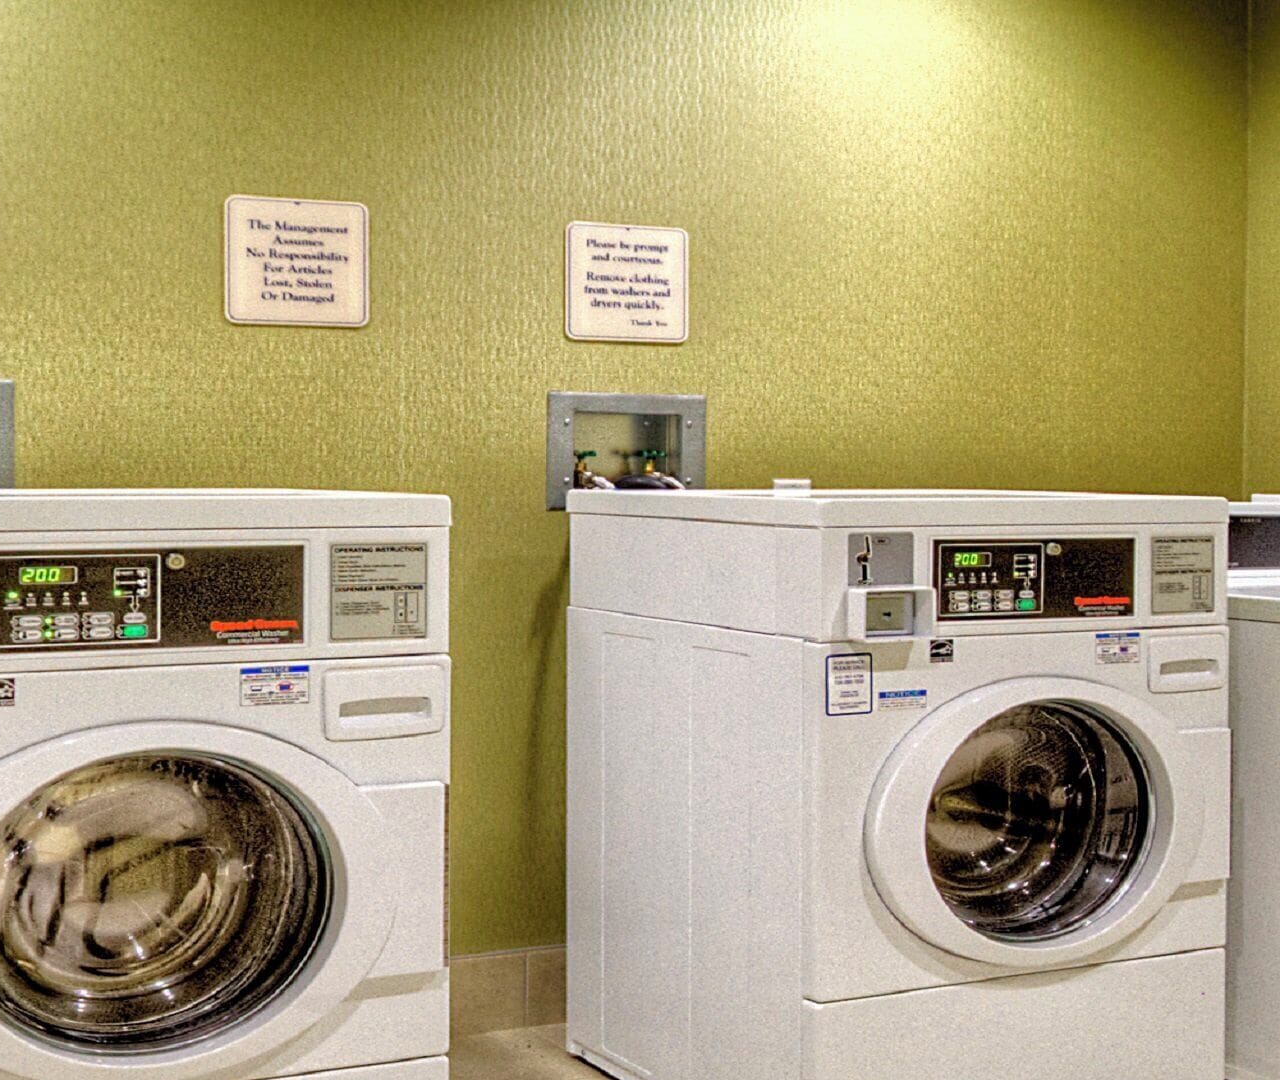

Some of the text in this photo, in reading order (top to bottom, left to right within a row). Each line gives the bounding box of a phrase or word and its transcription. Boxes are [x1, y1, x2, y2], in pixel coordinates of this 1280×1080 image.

[247, 219, 349, 235] The Management
[273, 234, 325, 247] Assumes
[586, 239, 669, 254] Please be prompt
[246, 247, 349, 264] No Responsibility
[591, 252, 664, 265] and courteous.
[263, 262, 333, 275] For Articles
[263, 276, 333, 289] Lost, Stolen
[586, 271, 669, 286] Remove clothing
[261, 291, 335, 305] Or Damaged
[584, 285, 671, 298] from washers and
[590, 298, 665, 311] dryers quickly.
[22, 567, 61, 583] 200
